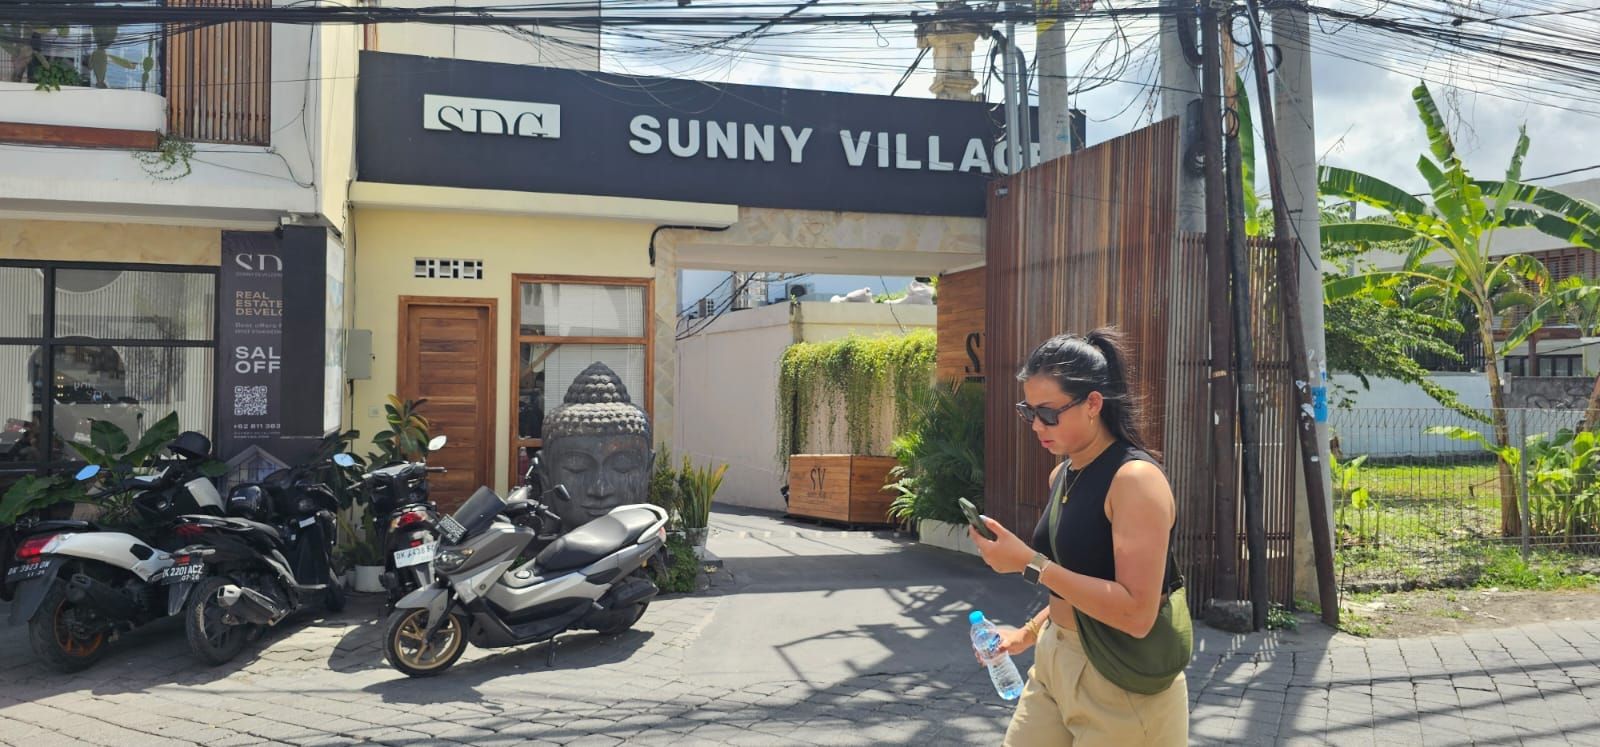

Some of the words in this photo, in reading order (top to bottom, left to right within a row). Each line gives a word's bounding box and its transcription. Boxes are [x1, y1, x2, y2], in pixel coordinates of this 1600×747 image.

[628, 113, 814, 163] SUNNY
[235, 290, 269, 299] REAL
[235, 299, 283, 308] ESTATE
[235, 360, 281, 374] OFF
[170, 566, 188, 577] 2201
